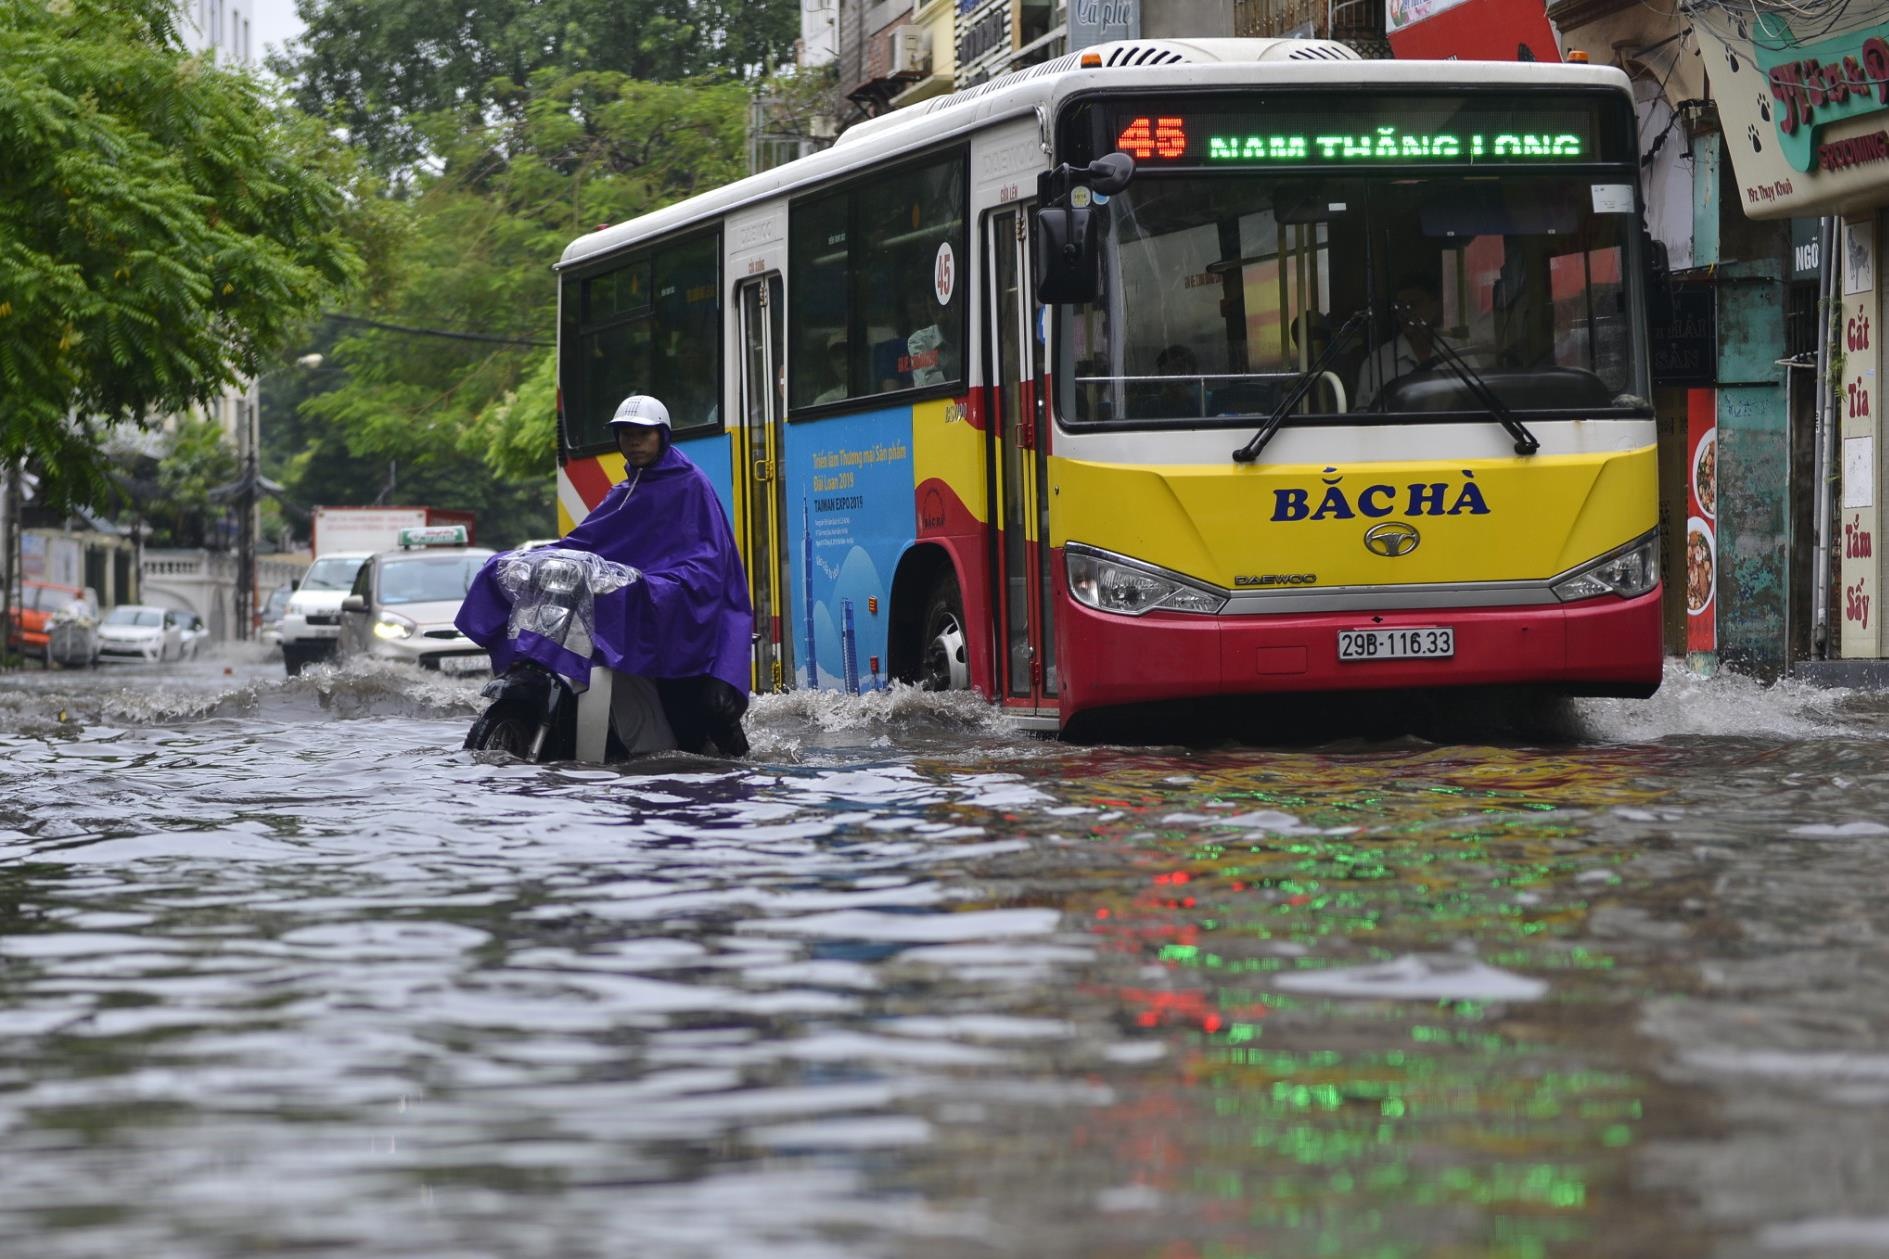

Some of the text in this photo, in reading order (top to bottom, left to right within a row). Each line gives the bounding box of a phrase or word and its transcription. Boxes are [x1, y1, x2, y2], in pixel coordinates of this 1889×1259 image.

[1117, 117, 1185, 158] 45
[1210, 135, 1305, 159] NAM
[1316, 127, 1460, 157] THĂNG
[1817, 131, 1889, 171] GROOMING
[938, 254, 951, 295] 45
[1847, 304, 1869, 352] Cắt
[839, 471, 855, 489] 2019
[814, 498, 835, 513] TAIWAN
[836, 496, 851, 511] EXPO
[1845, 513, 1872, 559] Tắm
[1234, 573, 1317, 586] DAEWOO
[1846, 577, 1870, 631] Sấy
[1341, 631, 1451, 658] 29B-116.33
